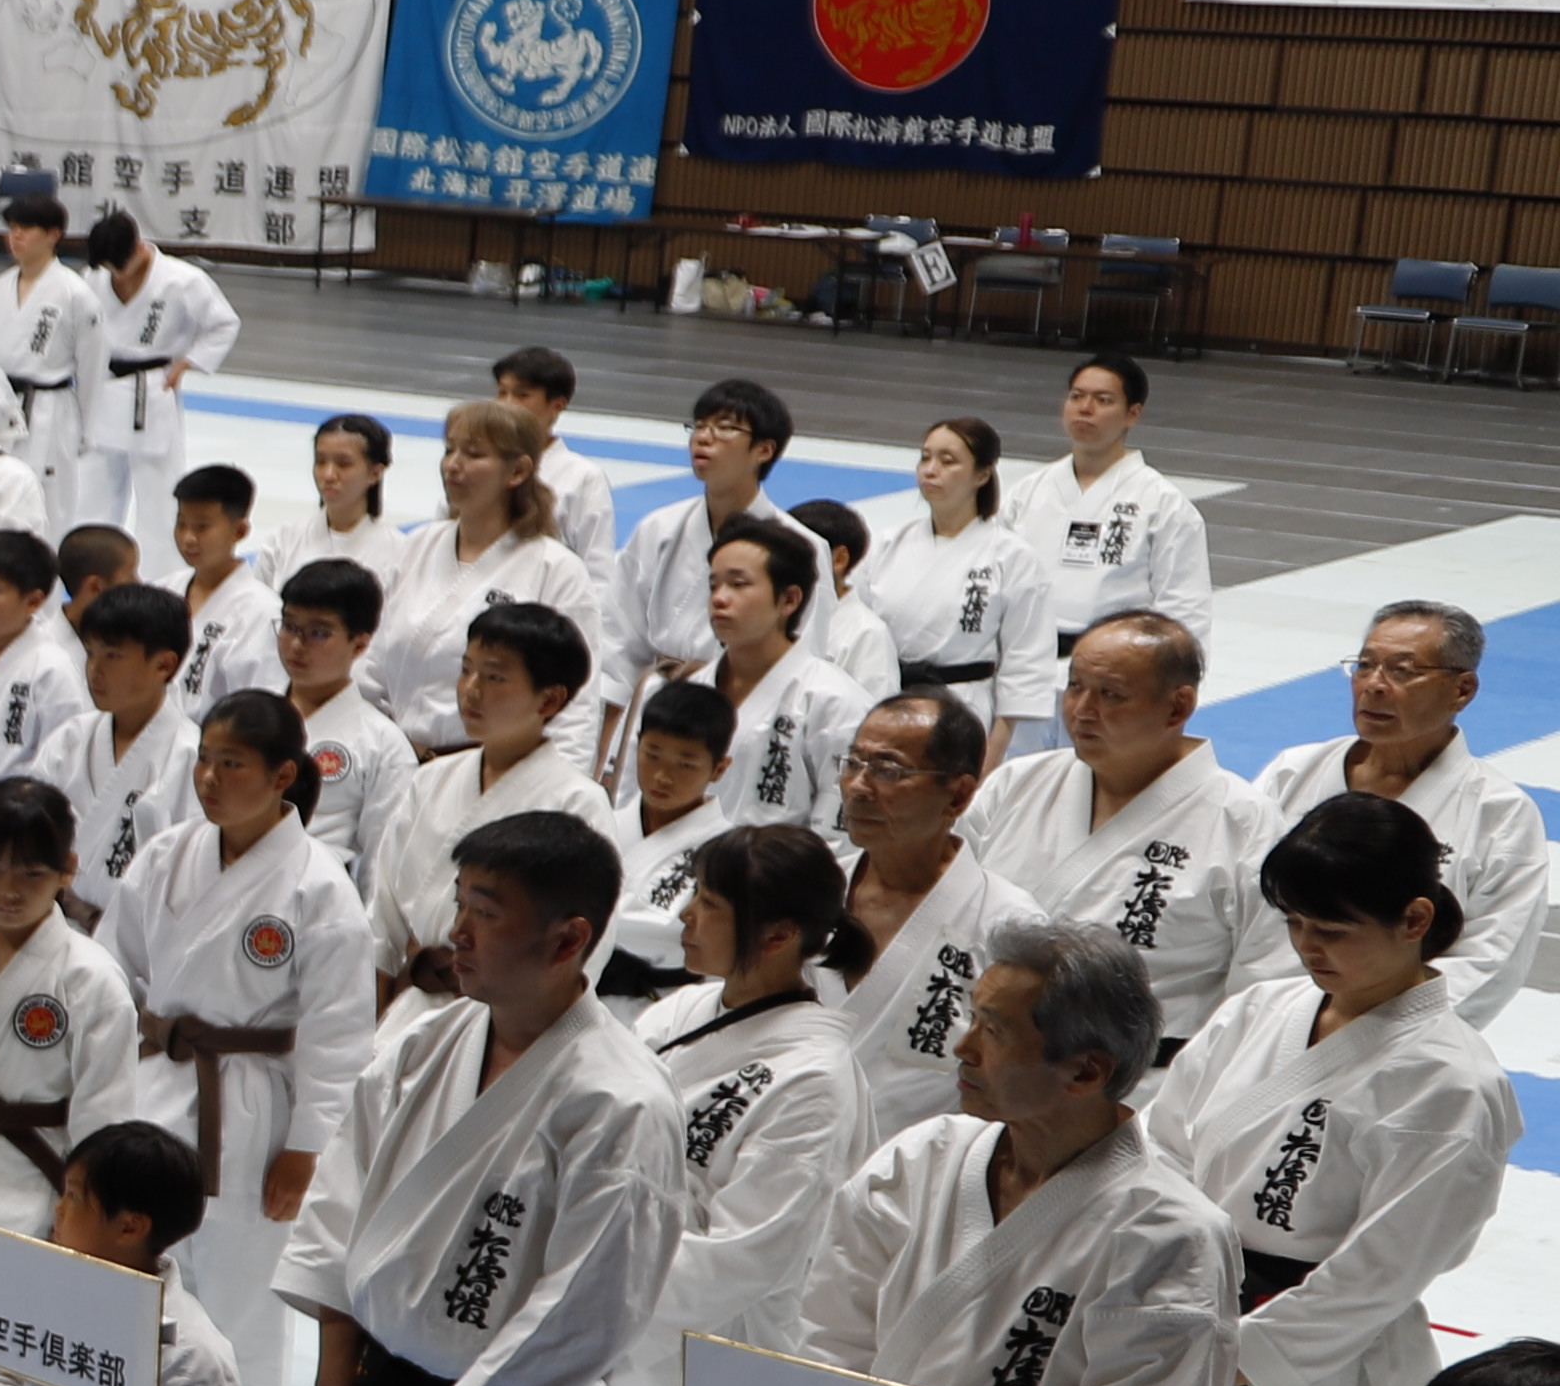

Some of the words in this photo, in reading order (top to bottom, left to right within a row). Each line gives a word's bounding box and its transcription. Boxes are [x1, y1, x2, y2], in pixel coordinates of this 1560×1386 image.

[723, 114, 798, 139] NPO法人
[410, 166, 493, 201] 北海道
[920, 247, 952, 285] E
